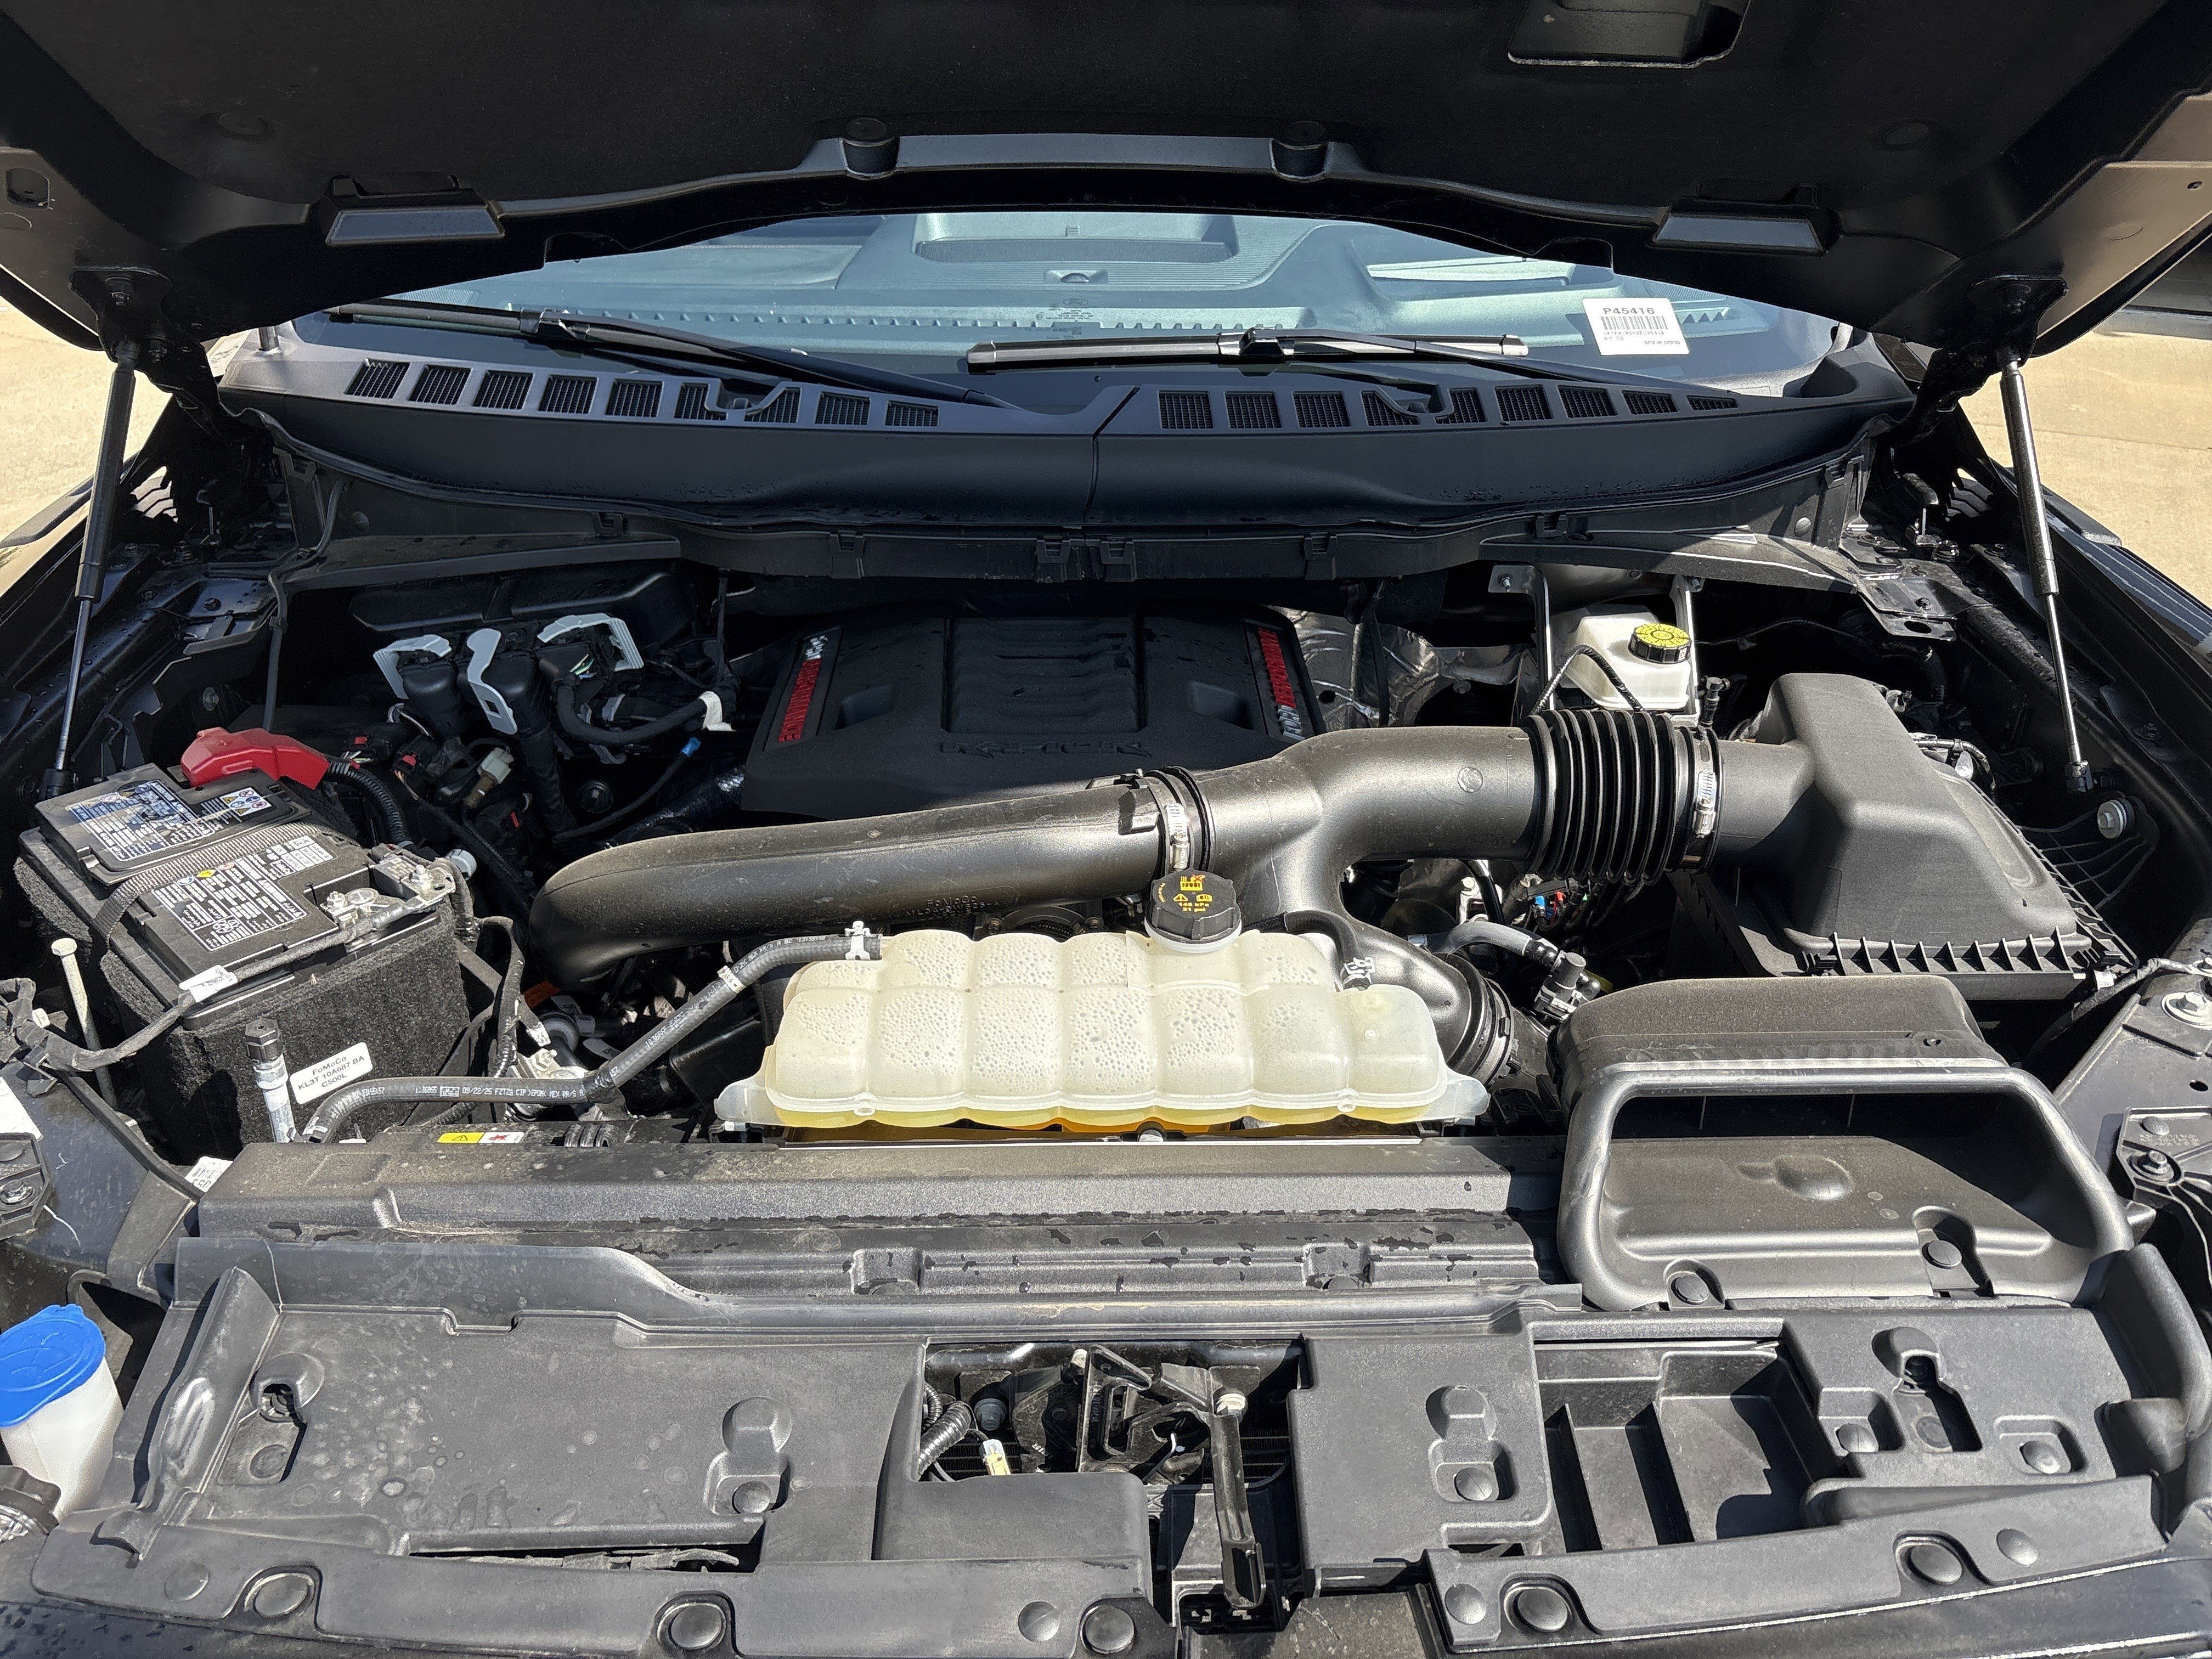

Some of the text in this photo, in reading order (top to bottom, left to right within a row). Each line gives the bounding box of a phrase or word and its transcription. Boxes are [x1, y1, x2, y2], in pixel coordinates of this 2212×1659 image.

[298, 1056, 365, 1090] KL3T 10A687 BA
[312, 1057, 347, 1075] FoMoCo
[321, 1073, 347, 1087] C500L
[462, 1087, 493, 1095] 09/22/25
